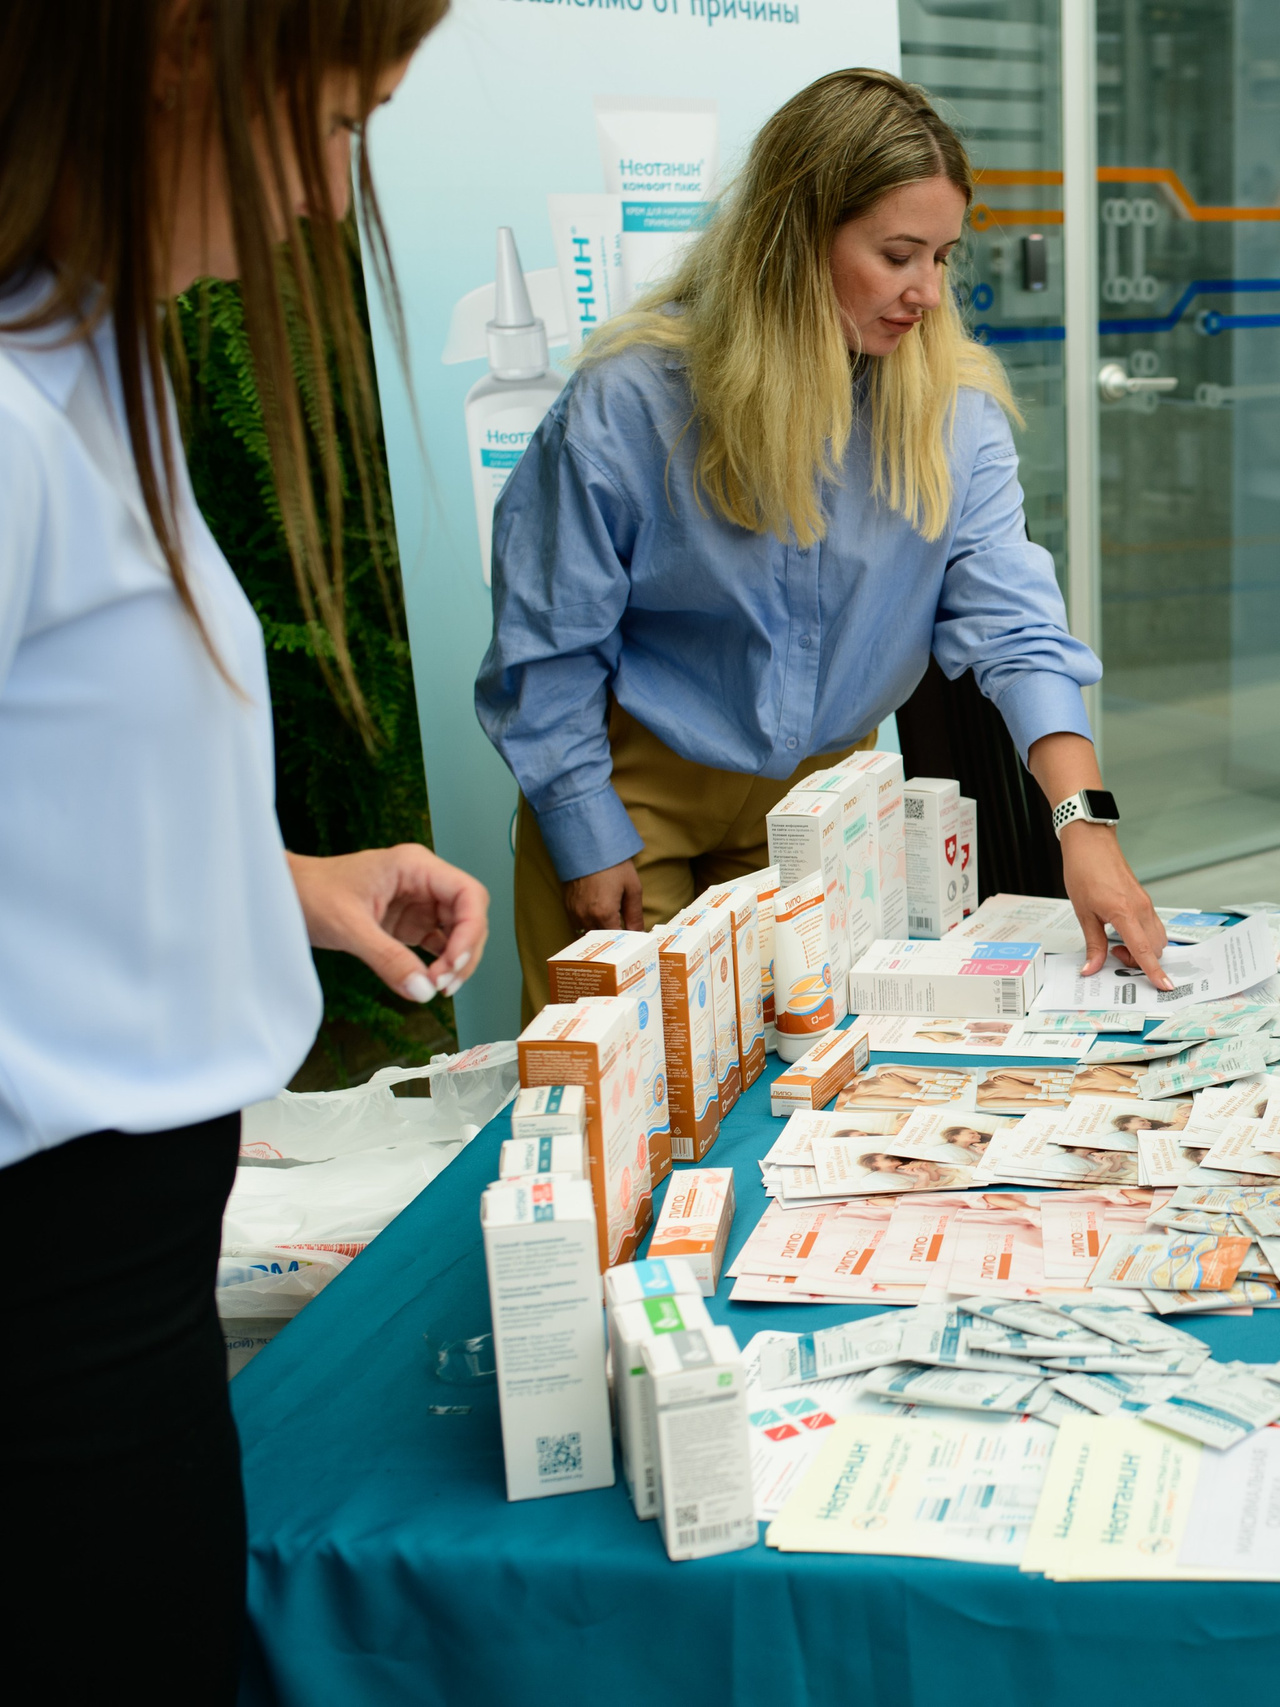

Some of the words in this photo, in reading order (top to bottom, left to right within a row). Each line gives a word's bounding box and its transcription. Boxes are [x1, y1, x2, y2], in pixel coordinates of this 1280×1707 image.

[690, 0, 800, 27] причины
[620, 159, 702, 177] Неотанин
[815, 1440, 871, 1521] Неотанин
[1099, 1450, 1141, 1546] Неотанин
